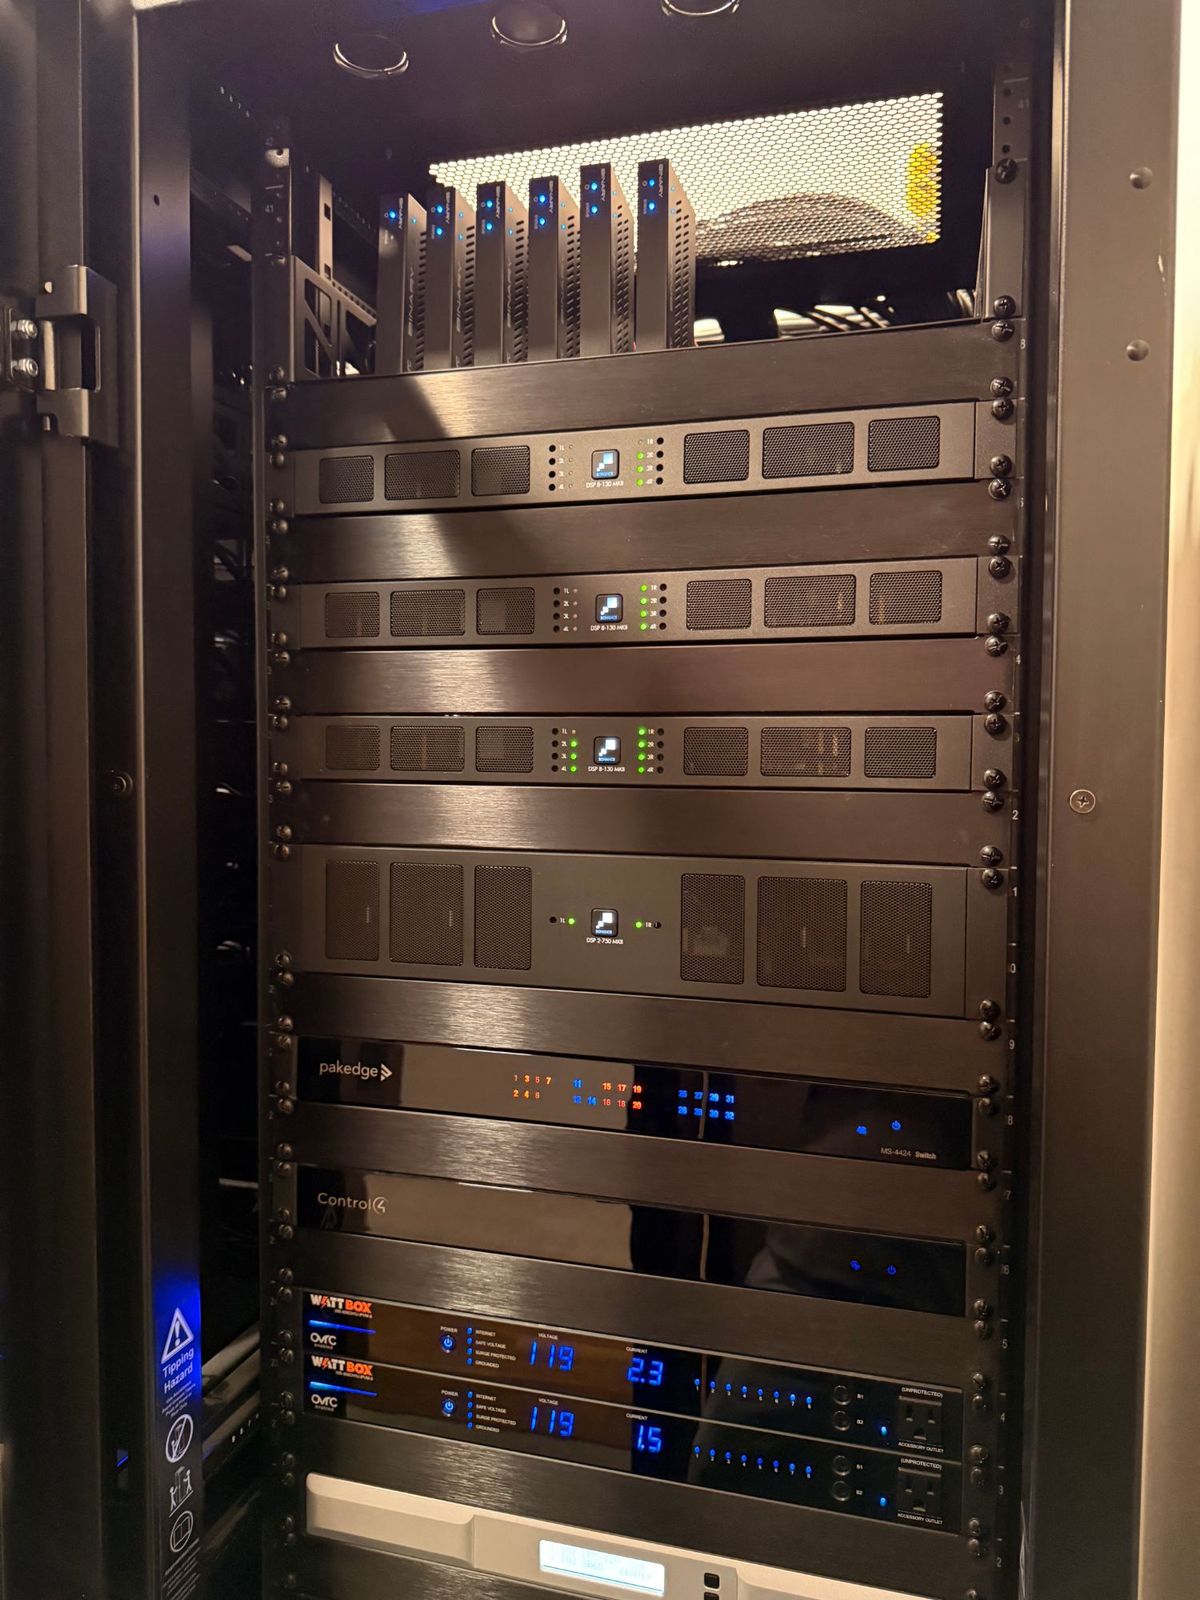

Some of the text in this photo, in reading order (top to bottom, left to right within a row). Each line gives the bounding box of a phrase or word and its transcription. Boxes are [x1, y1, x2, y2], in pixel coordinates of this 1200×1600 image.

[319, 1059, 378, 1080] pakedge
[524, 1074, 530, 1083] 3
[546, 1077, 552, 1085] 7
[573, 1080, 582, 1089] 11
[513, 1089, 519, 1098] 2
[523, 1090, 529, 1098] 4
[602, 1082, 642, 1094] 15 17 19
[588, 1096, 597, 1105] 14
[694, 1091, 703, 1099] 27
[709, 1093, 719, 1102] 29
[725, 1095, 734, 1104] 31
[632, 1101, 642, 1109] 20
[709, 1109, 719, 1118] 30
[725, 1111, 735, 1120] 32
[880, 1147, 937, 1160] MS-4424 Switch
[538, 1332, 558, 1340] VOLTAGE
[486, 1341, 506, 1349] VOLTAGE
[626, 1346, 648, 1354] CURRENT
[490, 1352, 517, 1361] PROTECTED
[529, 1340, 574, 1372] 119
[162, 1347, 194, 1378] Tipping
[475, 1360, 500, 1368] GROUNDED
[627, 1357, 663, 1386] 2.3
[164, 1362, 193, 1394] Hazard
[901, 1387, 943, 1398] (UNPROTECTED)
[538, 1398, 559, 1406] VOLTAGE
[487, 1406, 507, 1414] VOLTAGE
[491, 1416, 517, 1426] PROTECTED
[530, 1406, 574, 1437] 119
[626, 1412, 648, 1421] CURRENT
[476, 1425, 500, 1433] GROUNDED
[637, 1425, 662, 1453] 1.5
[898, 1442, 944, 1454] ACCESSORY OUTLET
[900, 1458, 942, 1470] (UNPROTECTED)
[897, 1512, 943, 1525] ACCESSORY OUTLET
